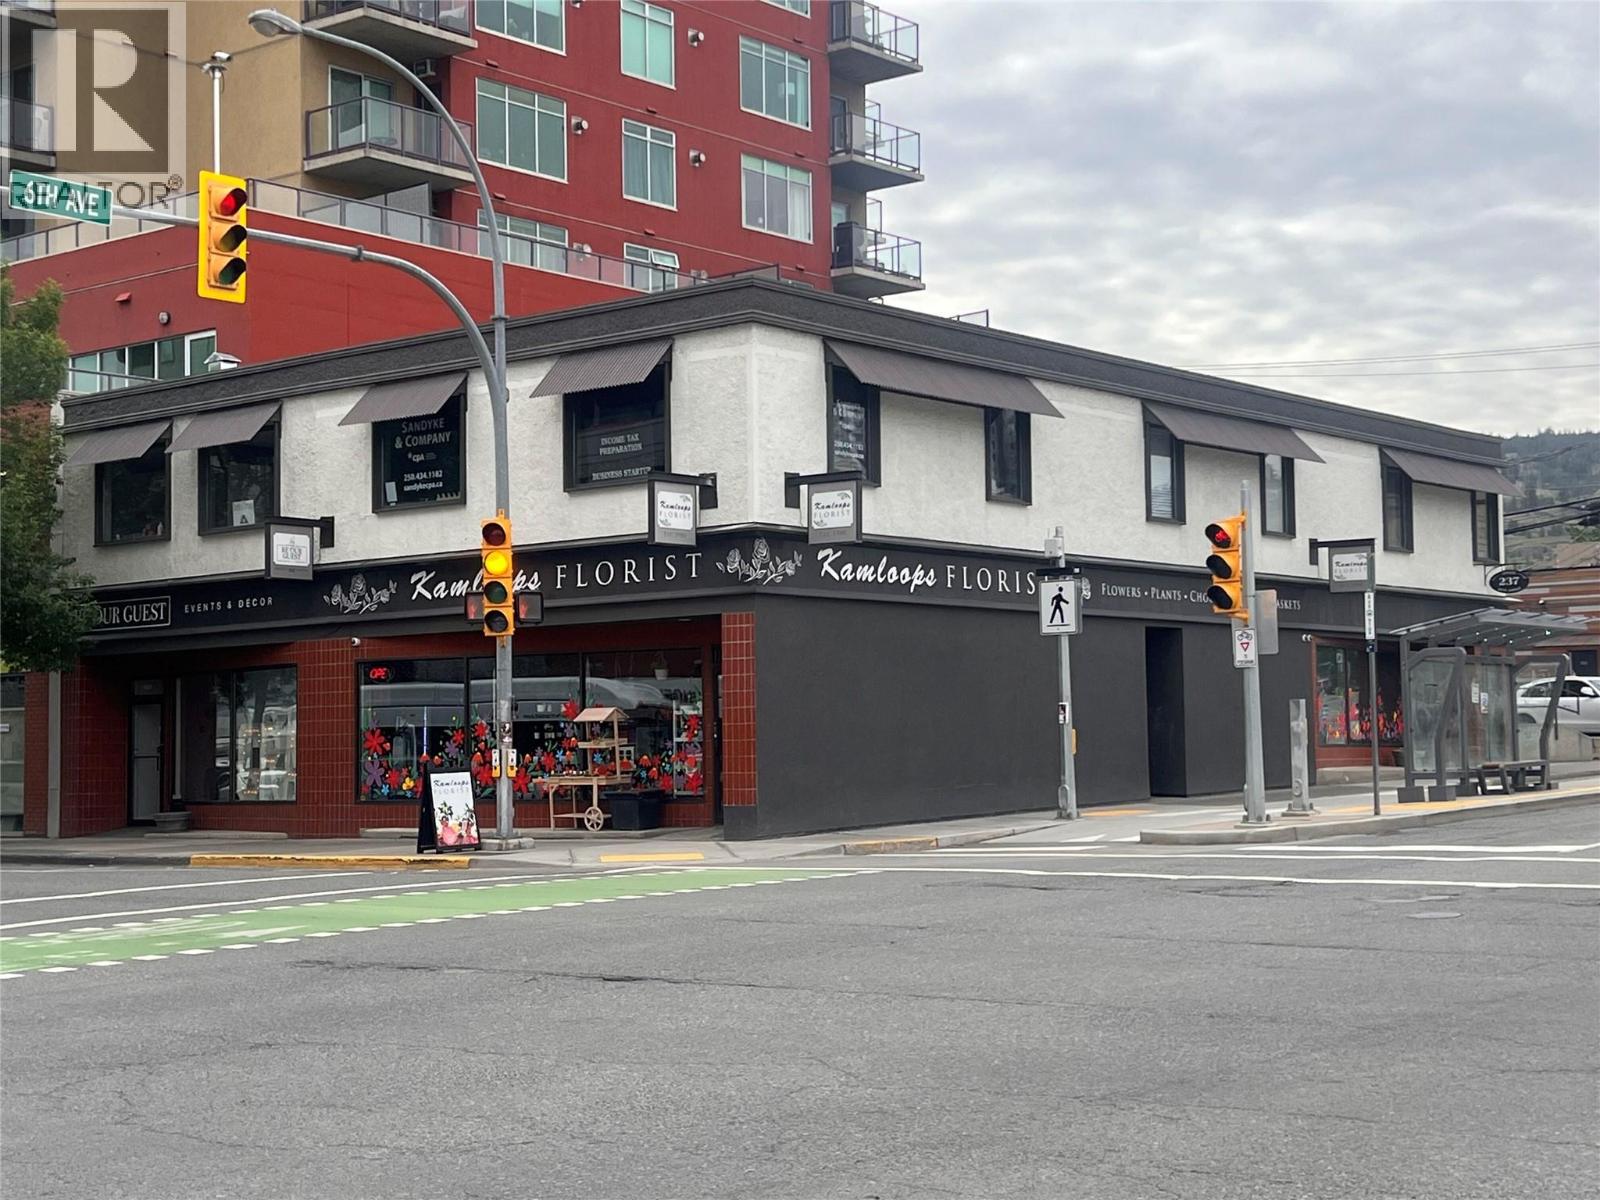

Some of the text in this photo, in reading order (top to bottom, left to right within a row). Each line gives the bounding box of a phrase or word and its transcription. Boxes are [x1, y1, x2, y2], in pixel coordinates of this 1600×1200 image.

[65, 188, 99, 217] AVE
[401, 417, 446, 433] SANDYKE
[395, 431, 452, 449] & COMPANY
[601, 433, 640, 446] INCOME TAX
[600, 442, 643, 456] PREPARATION
[592, 470, 622, 481] BUSINESS
[410, 553, 702, 600] Kamlps FLORIST
[817, 548, 1036, 595] Kamloops FLORIS
[1498, 576, 1520, 586] 237
[1101, 582, 1141, 598] FLOWERS
[1150, 588, 1181, 601] PLANTS
[123, 602, 167, 623] GUEST
[184, 601, 222, 613] EVENTS
[226, 600, 232, 609] &
